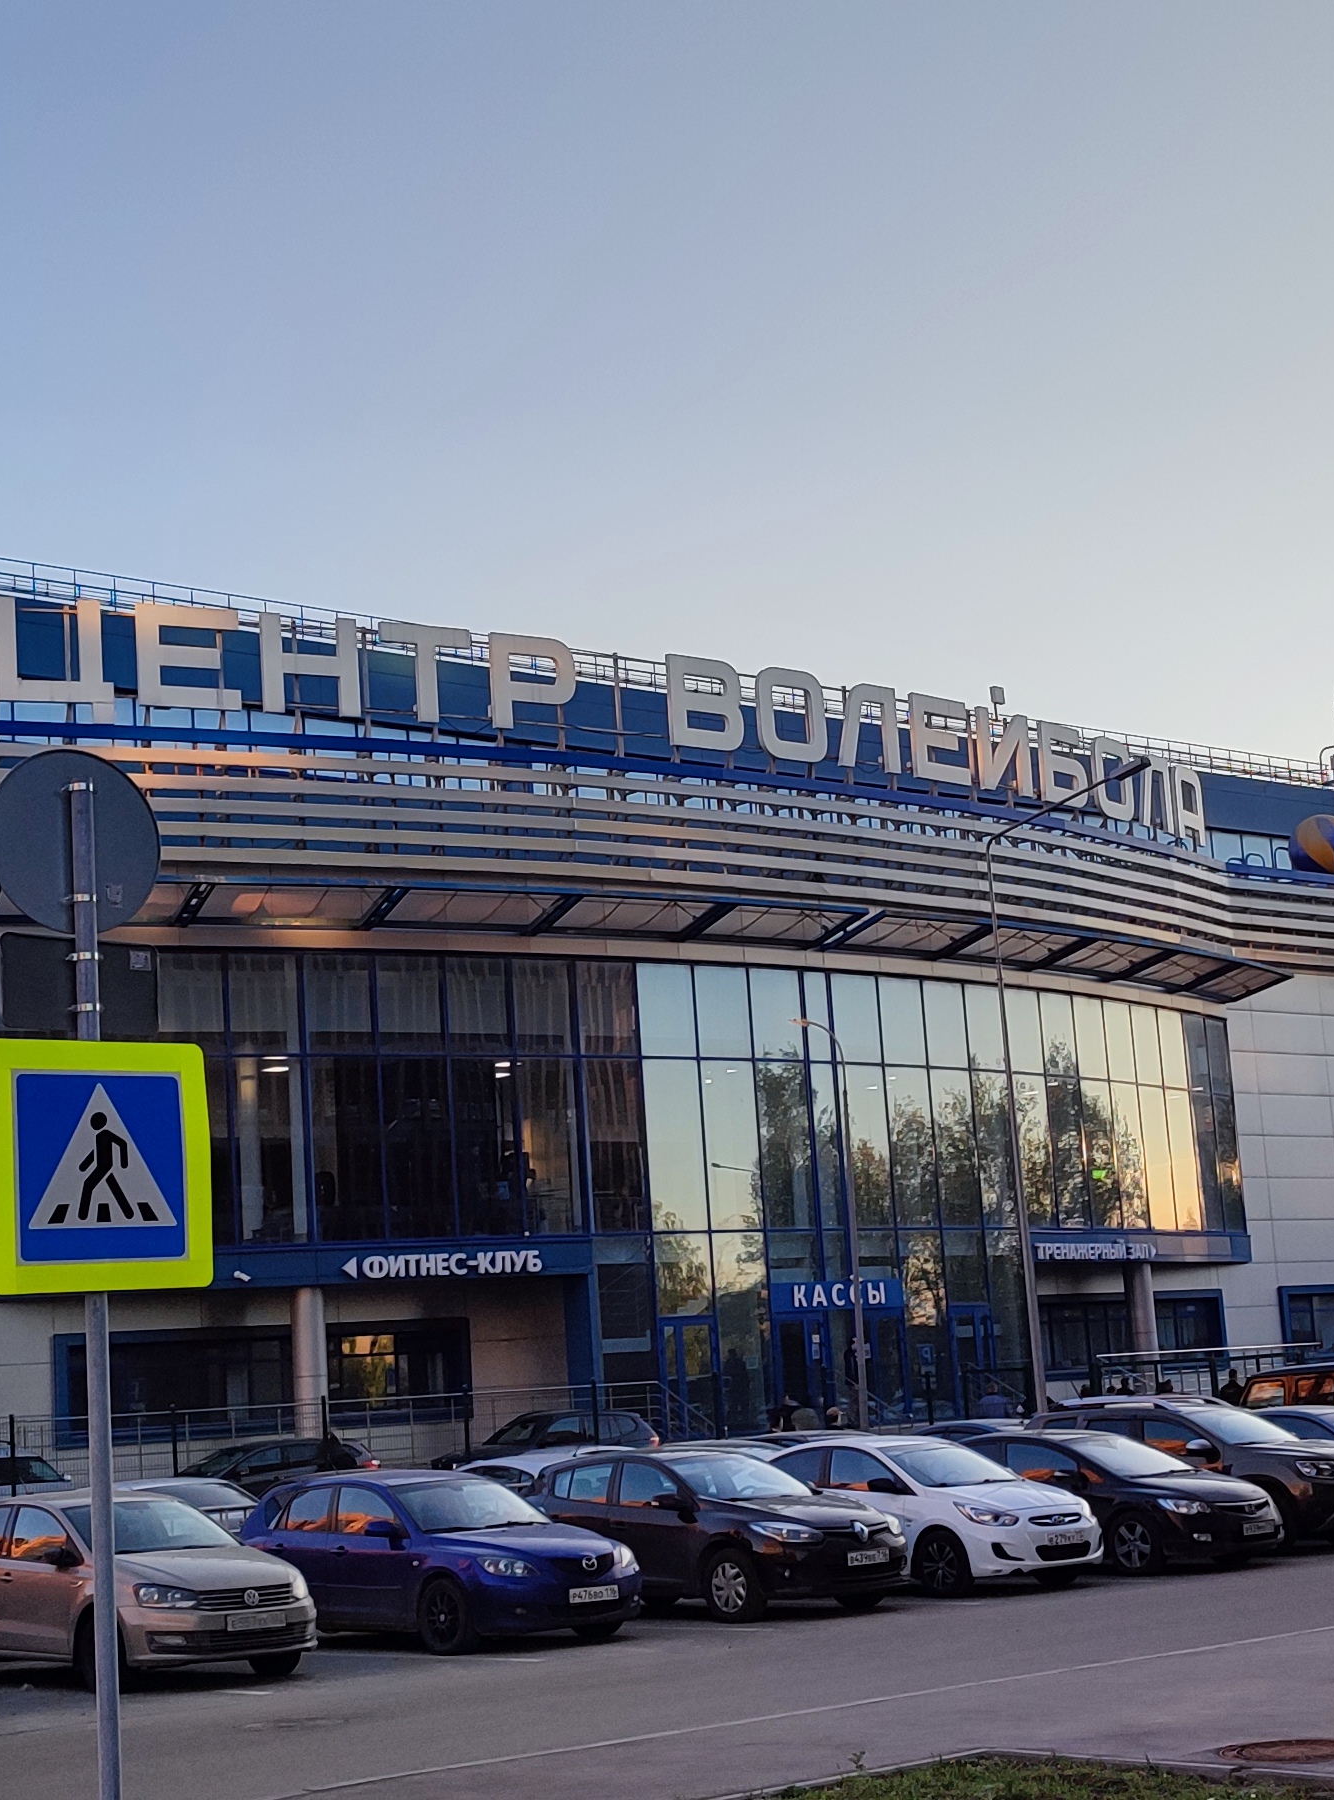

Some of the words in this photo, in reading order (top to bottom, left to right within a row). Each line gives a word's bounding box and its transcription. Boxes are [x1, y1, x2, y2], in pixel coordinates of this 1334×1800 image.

[665, 653, 1207, 848] ВОЛЕЙБОЛА
[1034, 1239, 1127, 1260] ТРЕНАЖЕРНЫЙ
[1127, 1243, 1149, 1259] ЗАЛ
[362, 1250, 543, 1279] ФИТНЕС-КЛУБ
[793, 1281, 886, 1308] КАССЫ
